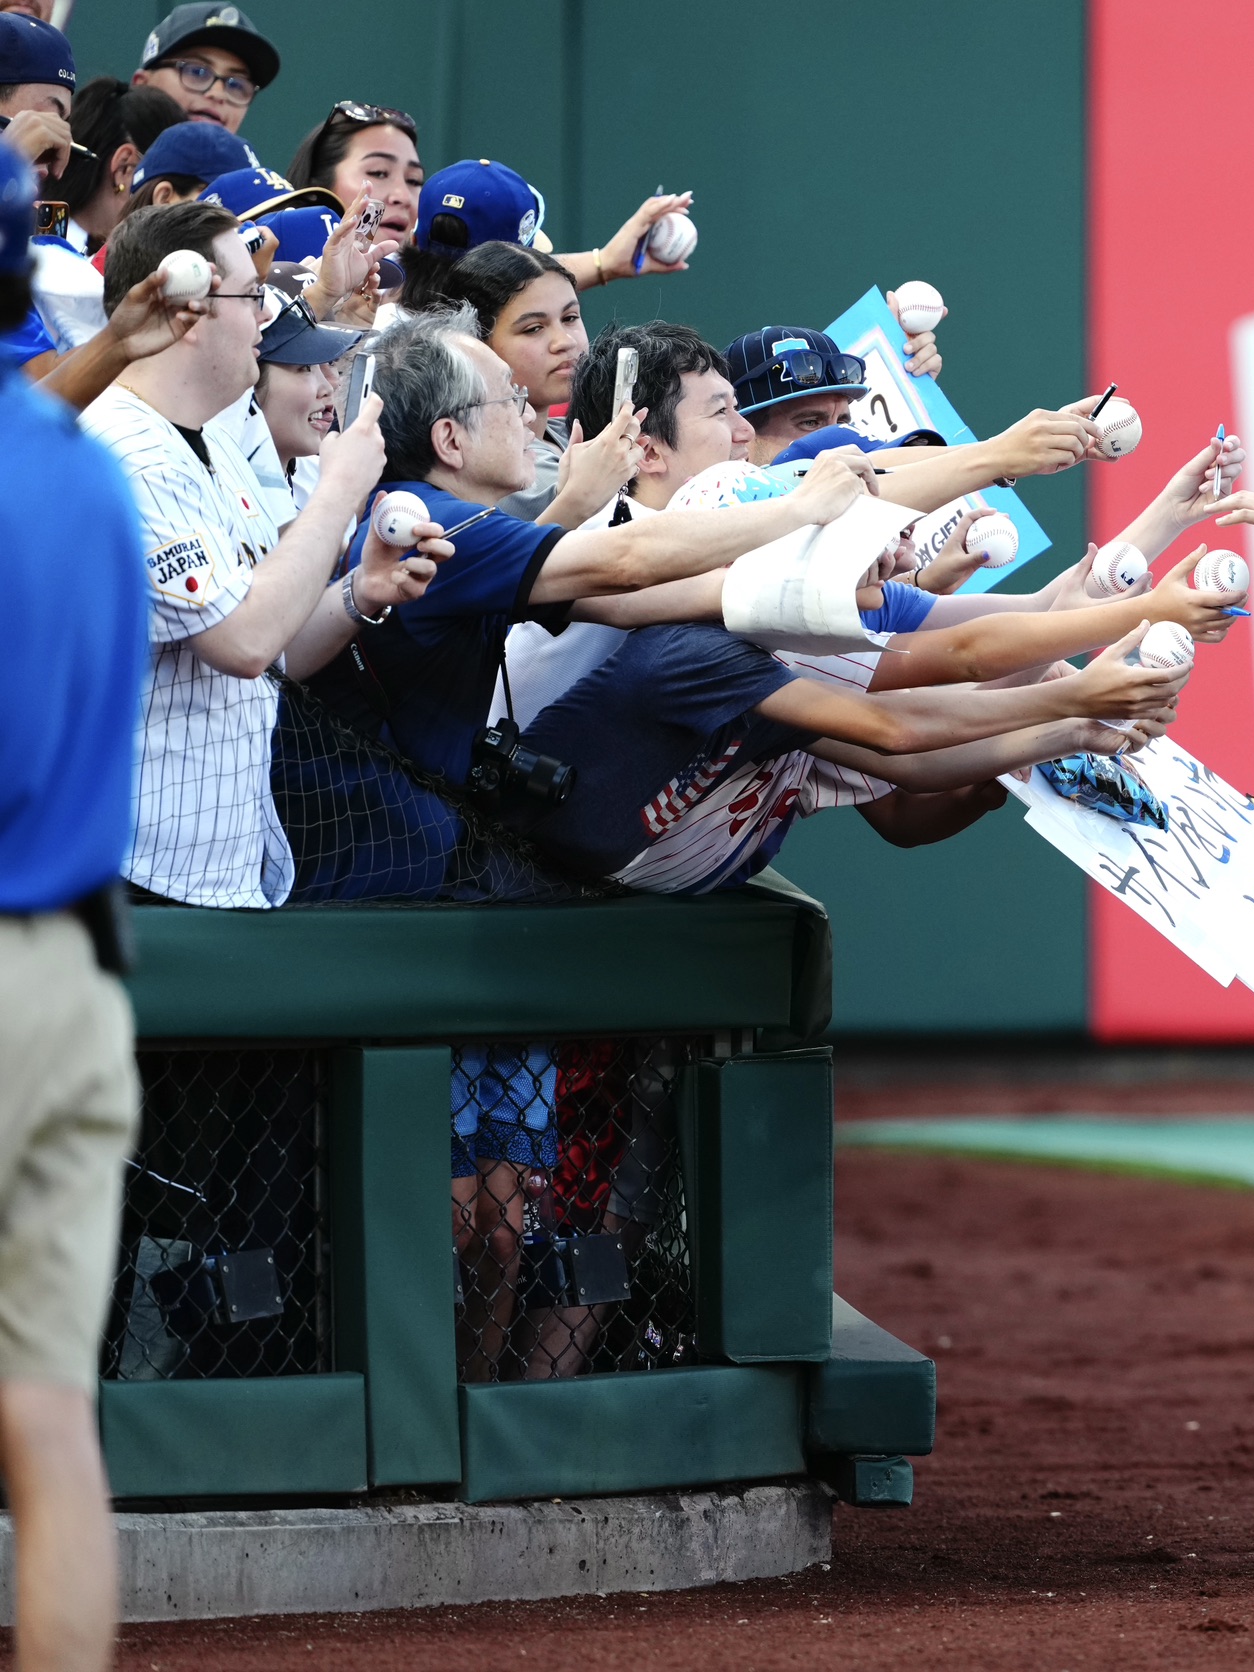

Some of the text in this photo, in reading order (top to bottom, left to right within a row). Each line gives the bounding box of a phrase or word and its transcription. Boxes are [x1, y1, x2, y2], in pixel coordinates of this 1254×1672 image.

[146, 538, 203, 569] SAMURAI
[157, 550, 210, 585] JAPAN
[350, 643, 365, 671] Canon
